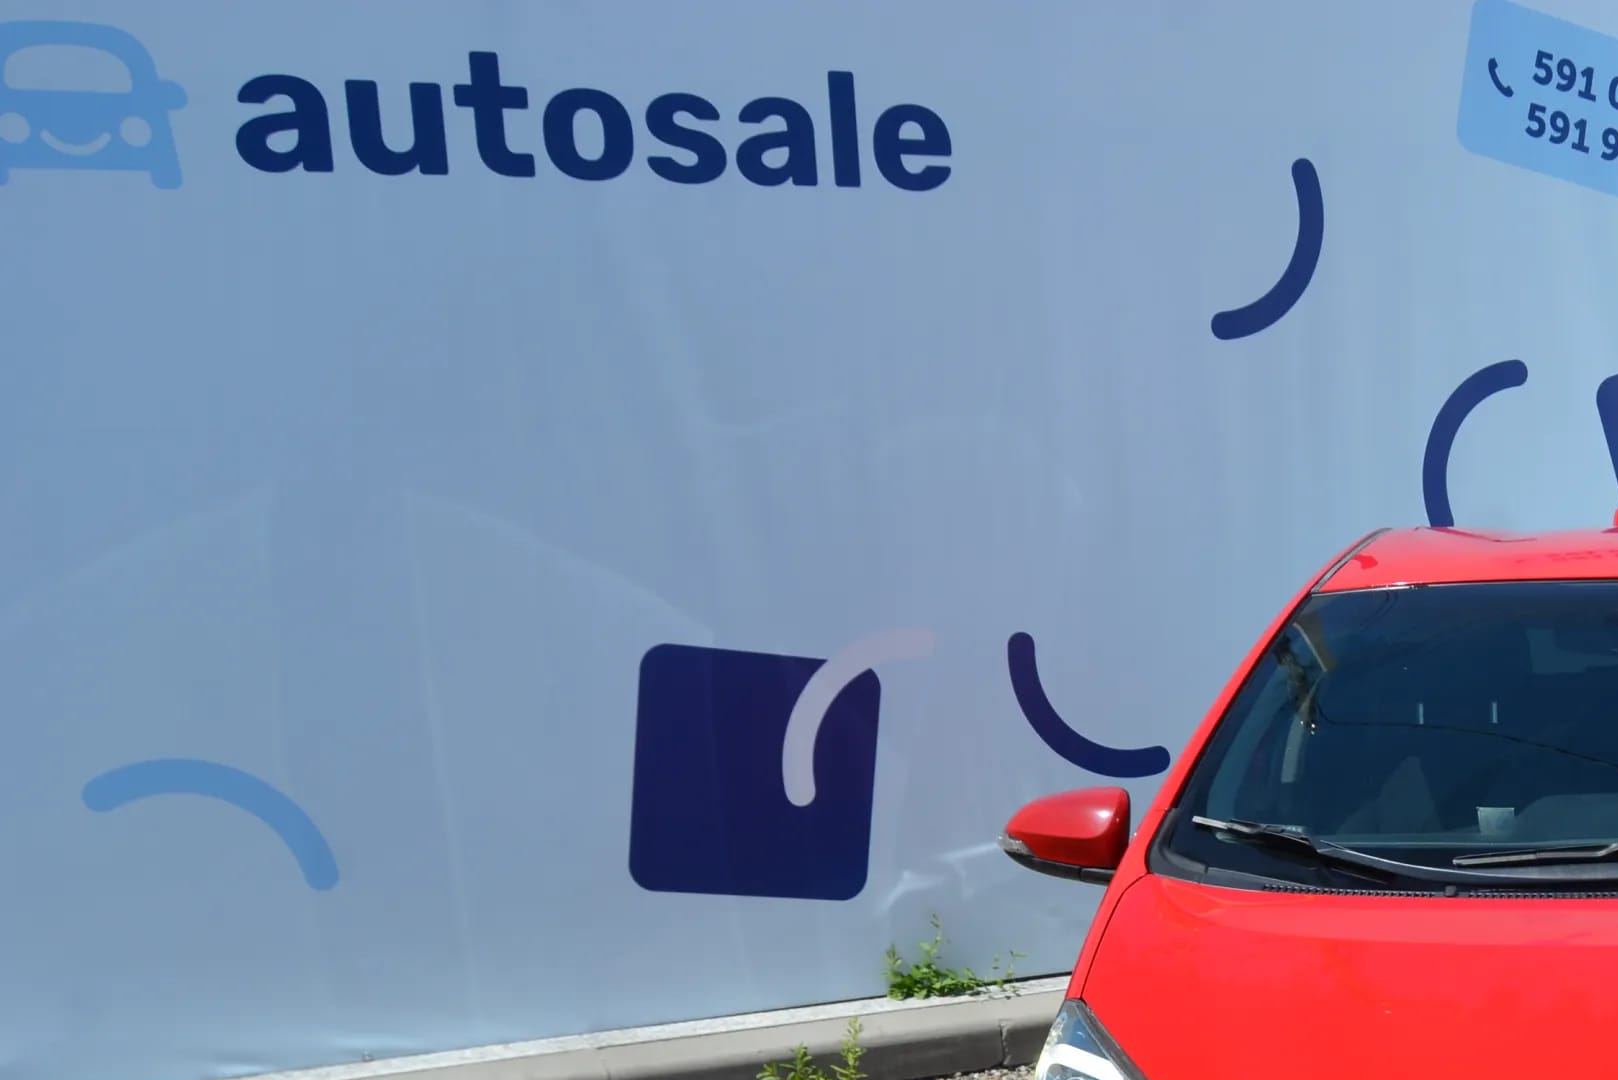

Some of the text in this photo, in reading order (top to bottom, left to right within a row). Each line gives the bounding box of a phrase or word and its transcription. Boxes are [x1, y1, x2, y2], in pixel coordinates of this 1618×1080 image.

[1532, 50, 1597, 102] 591
[235, 50, 953, 191] autosale
[1525, 102, 1590, 154] 591
